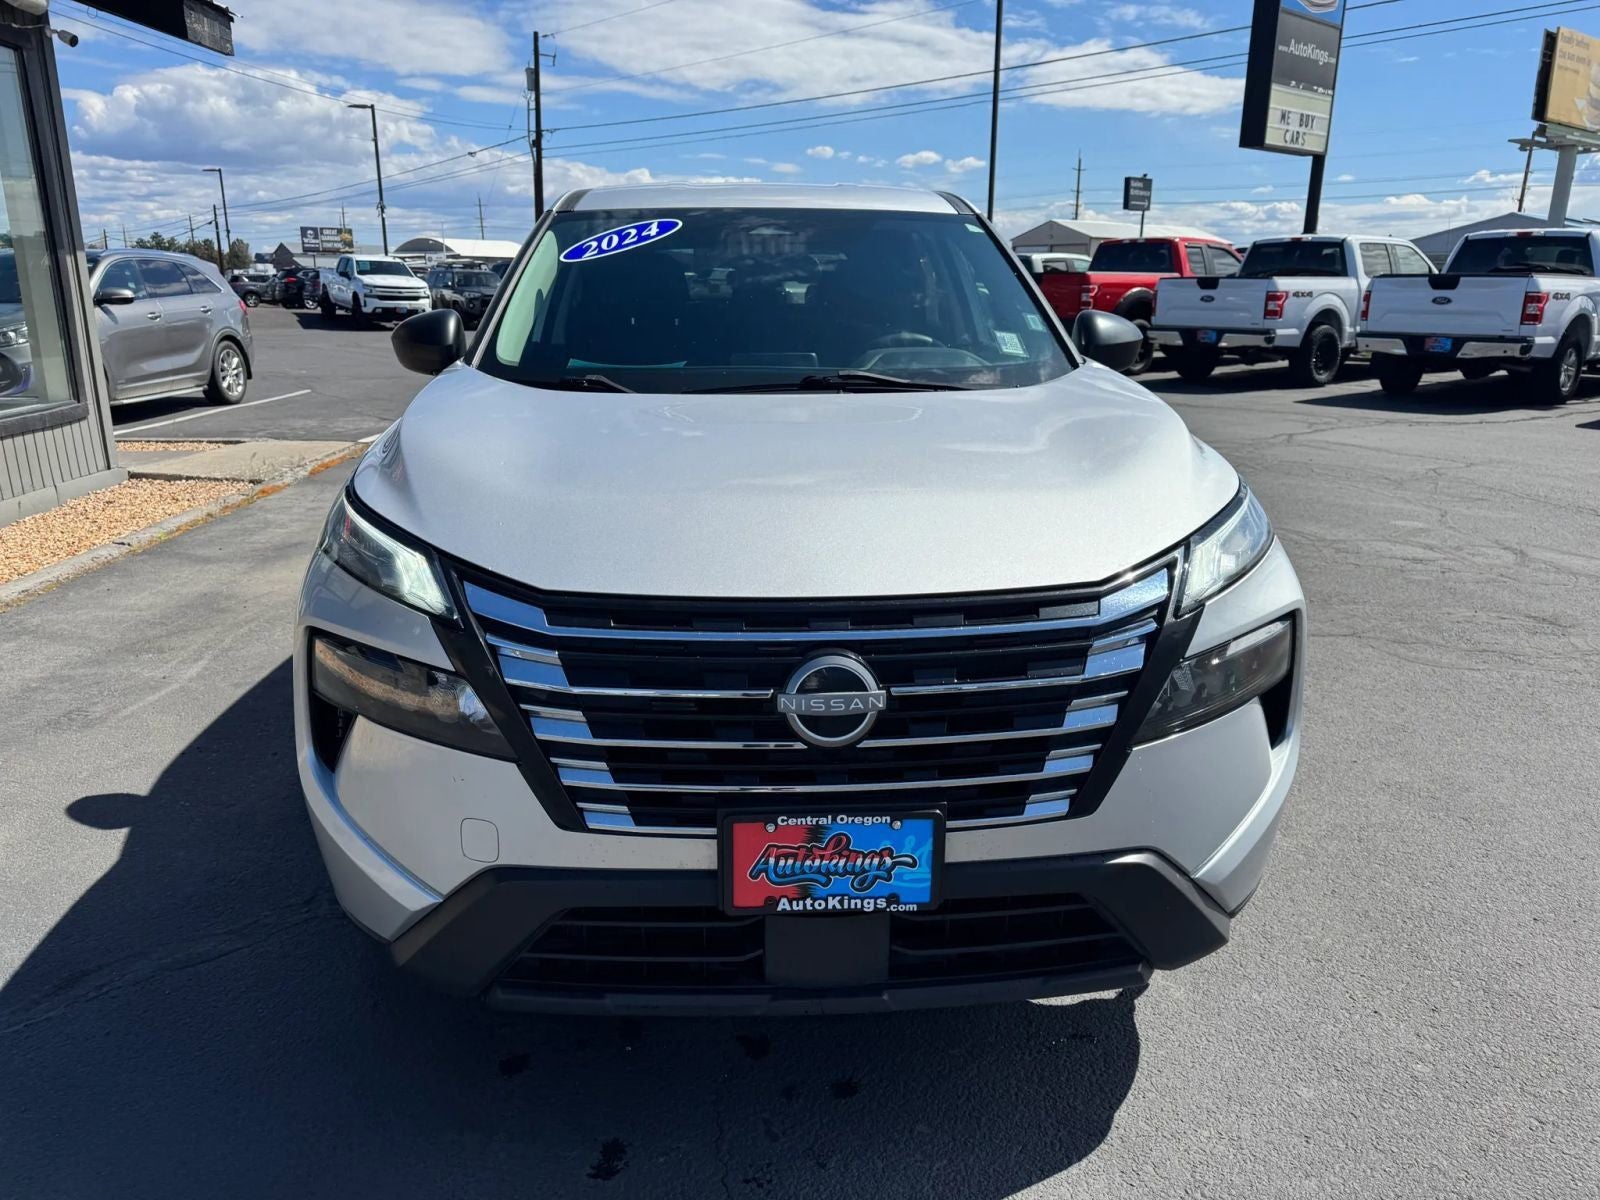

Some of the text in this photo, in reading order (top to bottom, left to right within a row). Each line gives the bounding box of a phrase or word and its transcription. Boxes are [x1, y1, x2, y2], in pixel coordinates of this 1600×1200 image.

[1299, 112, 1316, 129] BUY
[1283, 129, 1307, 146] CARS
[581, 221, 660, 259] 2024
[780, 695, 884, 711] NISSAN
[777, 814, 891, 825] Central Oregon
[776, 896, 918, 912] AutoKings.com
